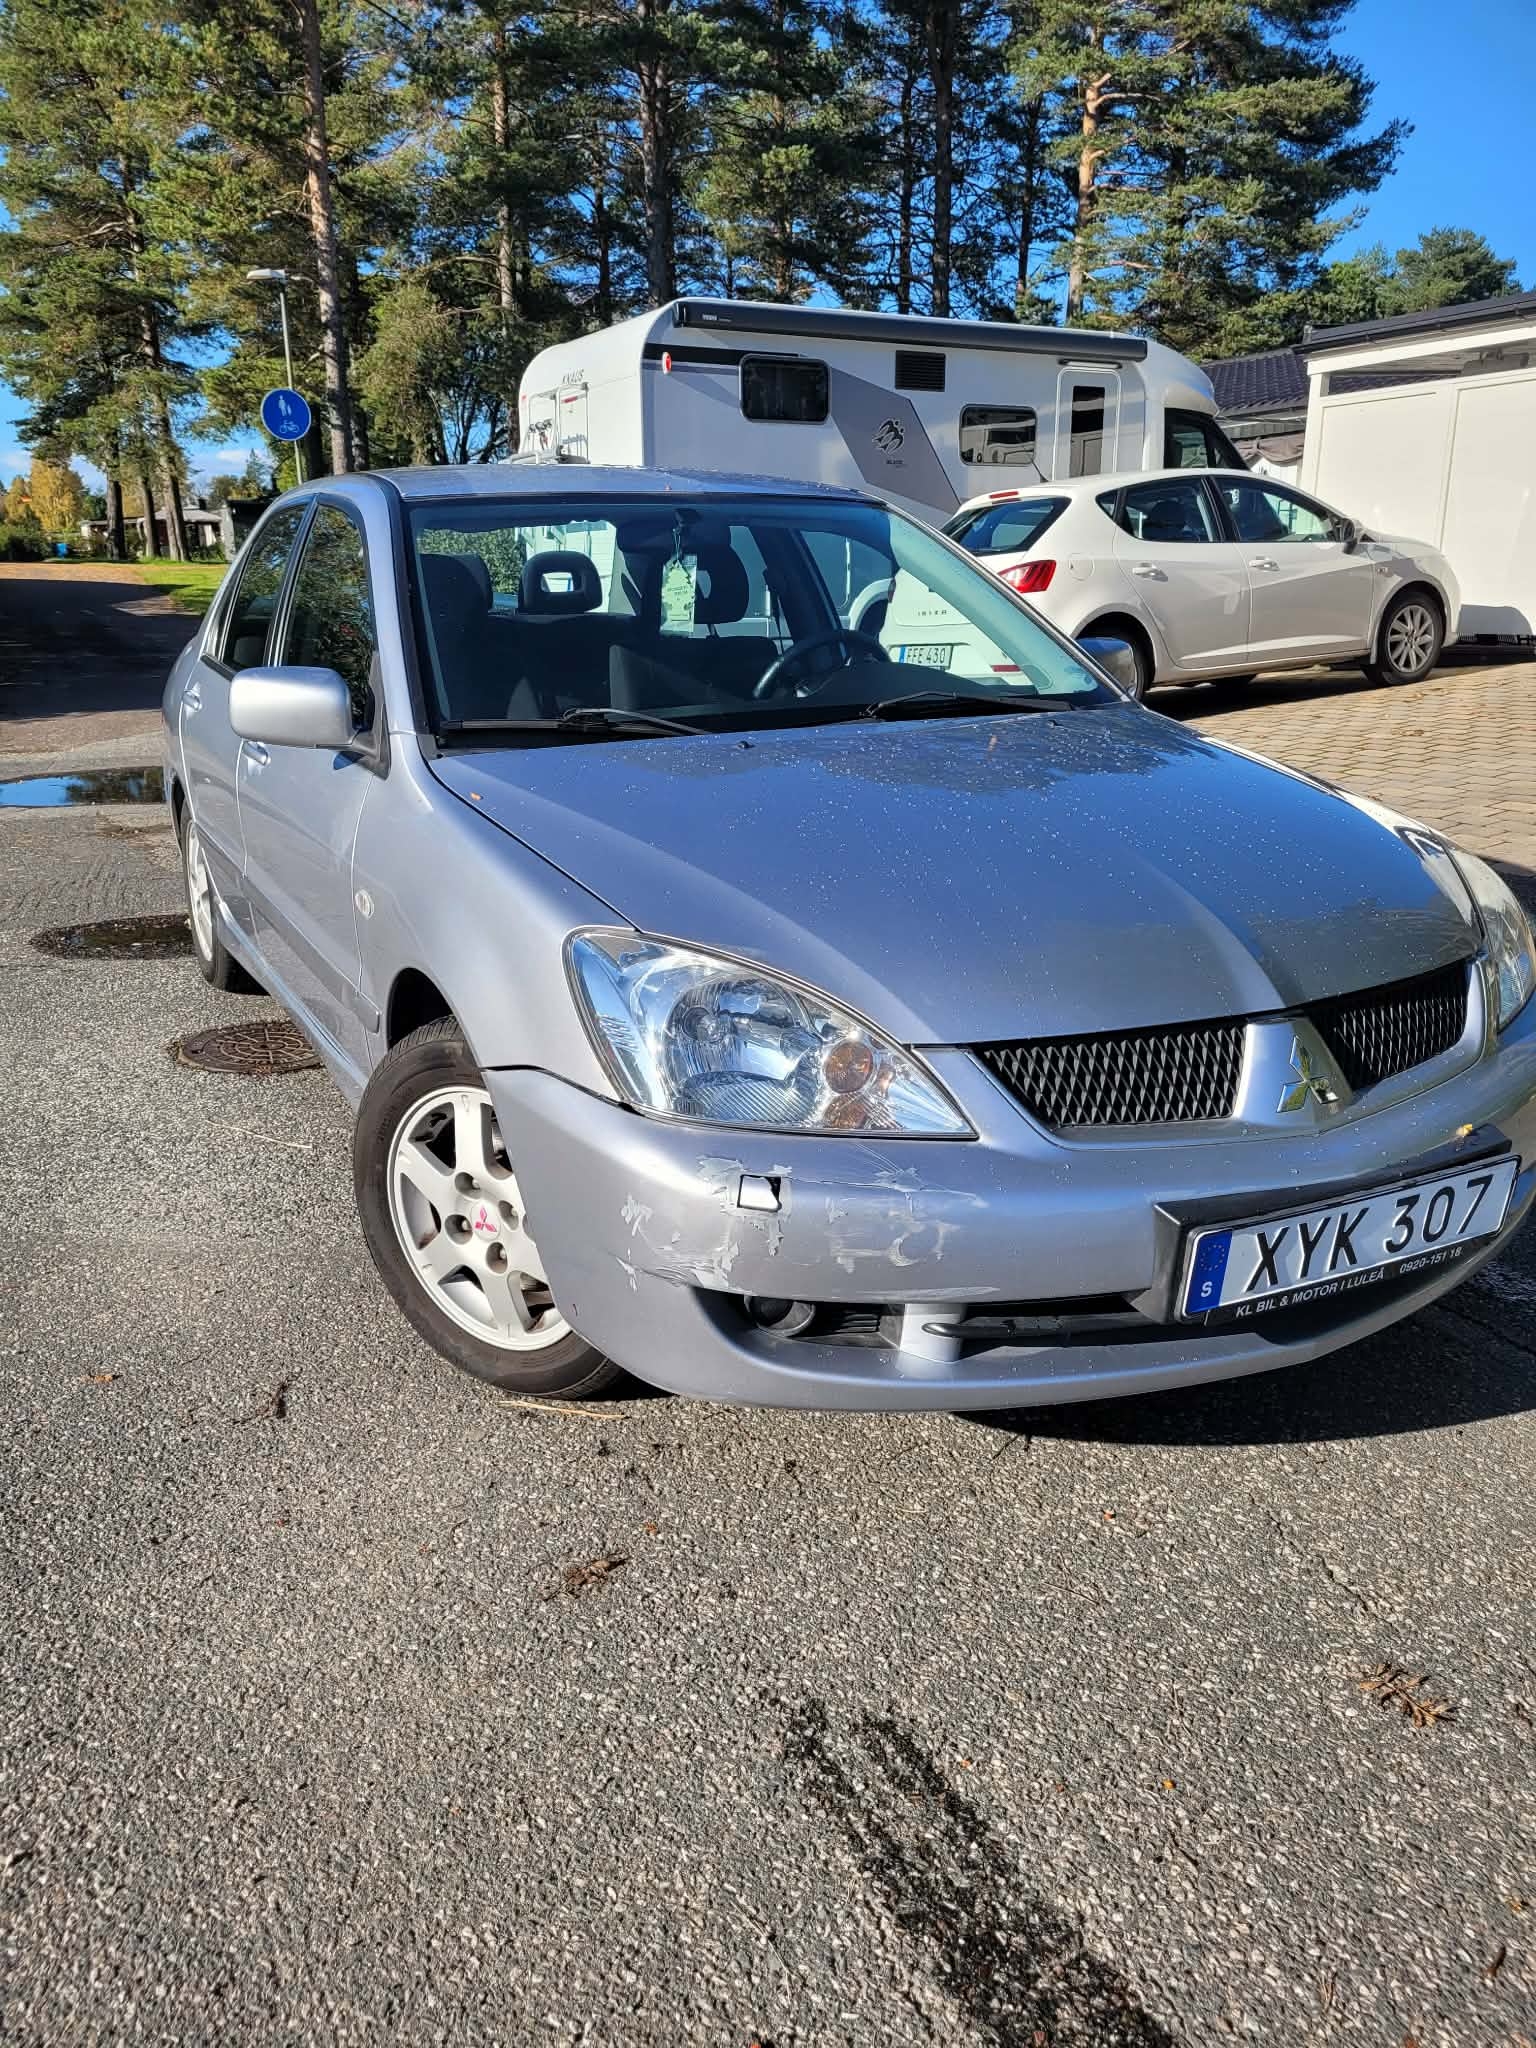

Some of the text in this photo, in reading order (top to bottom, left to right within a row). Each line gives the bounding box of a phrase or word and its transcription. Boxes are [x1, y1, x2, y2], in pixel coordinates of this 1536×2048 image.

[907, 647, 946, 664] FFE 430
[1242, 1173, 1495, 1294] XYK 307
[1200, 1280, 1213, 1298] S
[1235, 1304, 1253, 1319] KL
[1256, 1299, 1277, 1314] BIL
[1279, 1295, 1290, 1307] &
[1292, 1281, 1338, 1304] MOTOR
[1346, 1266, 1385, 1289] LULEÅ
[1399, 1251, 1447, 1274] 0920-151
[1449, 1246, 1463, 1258] 18
